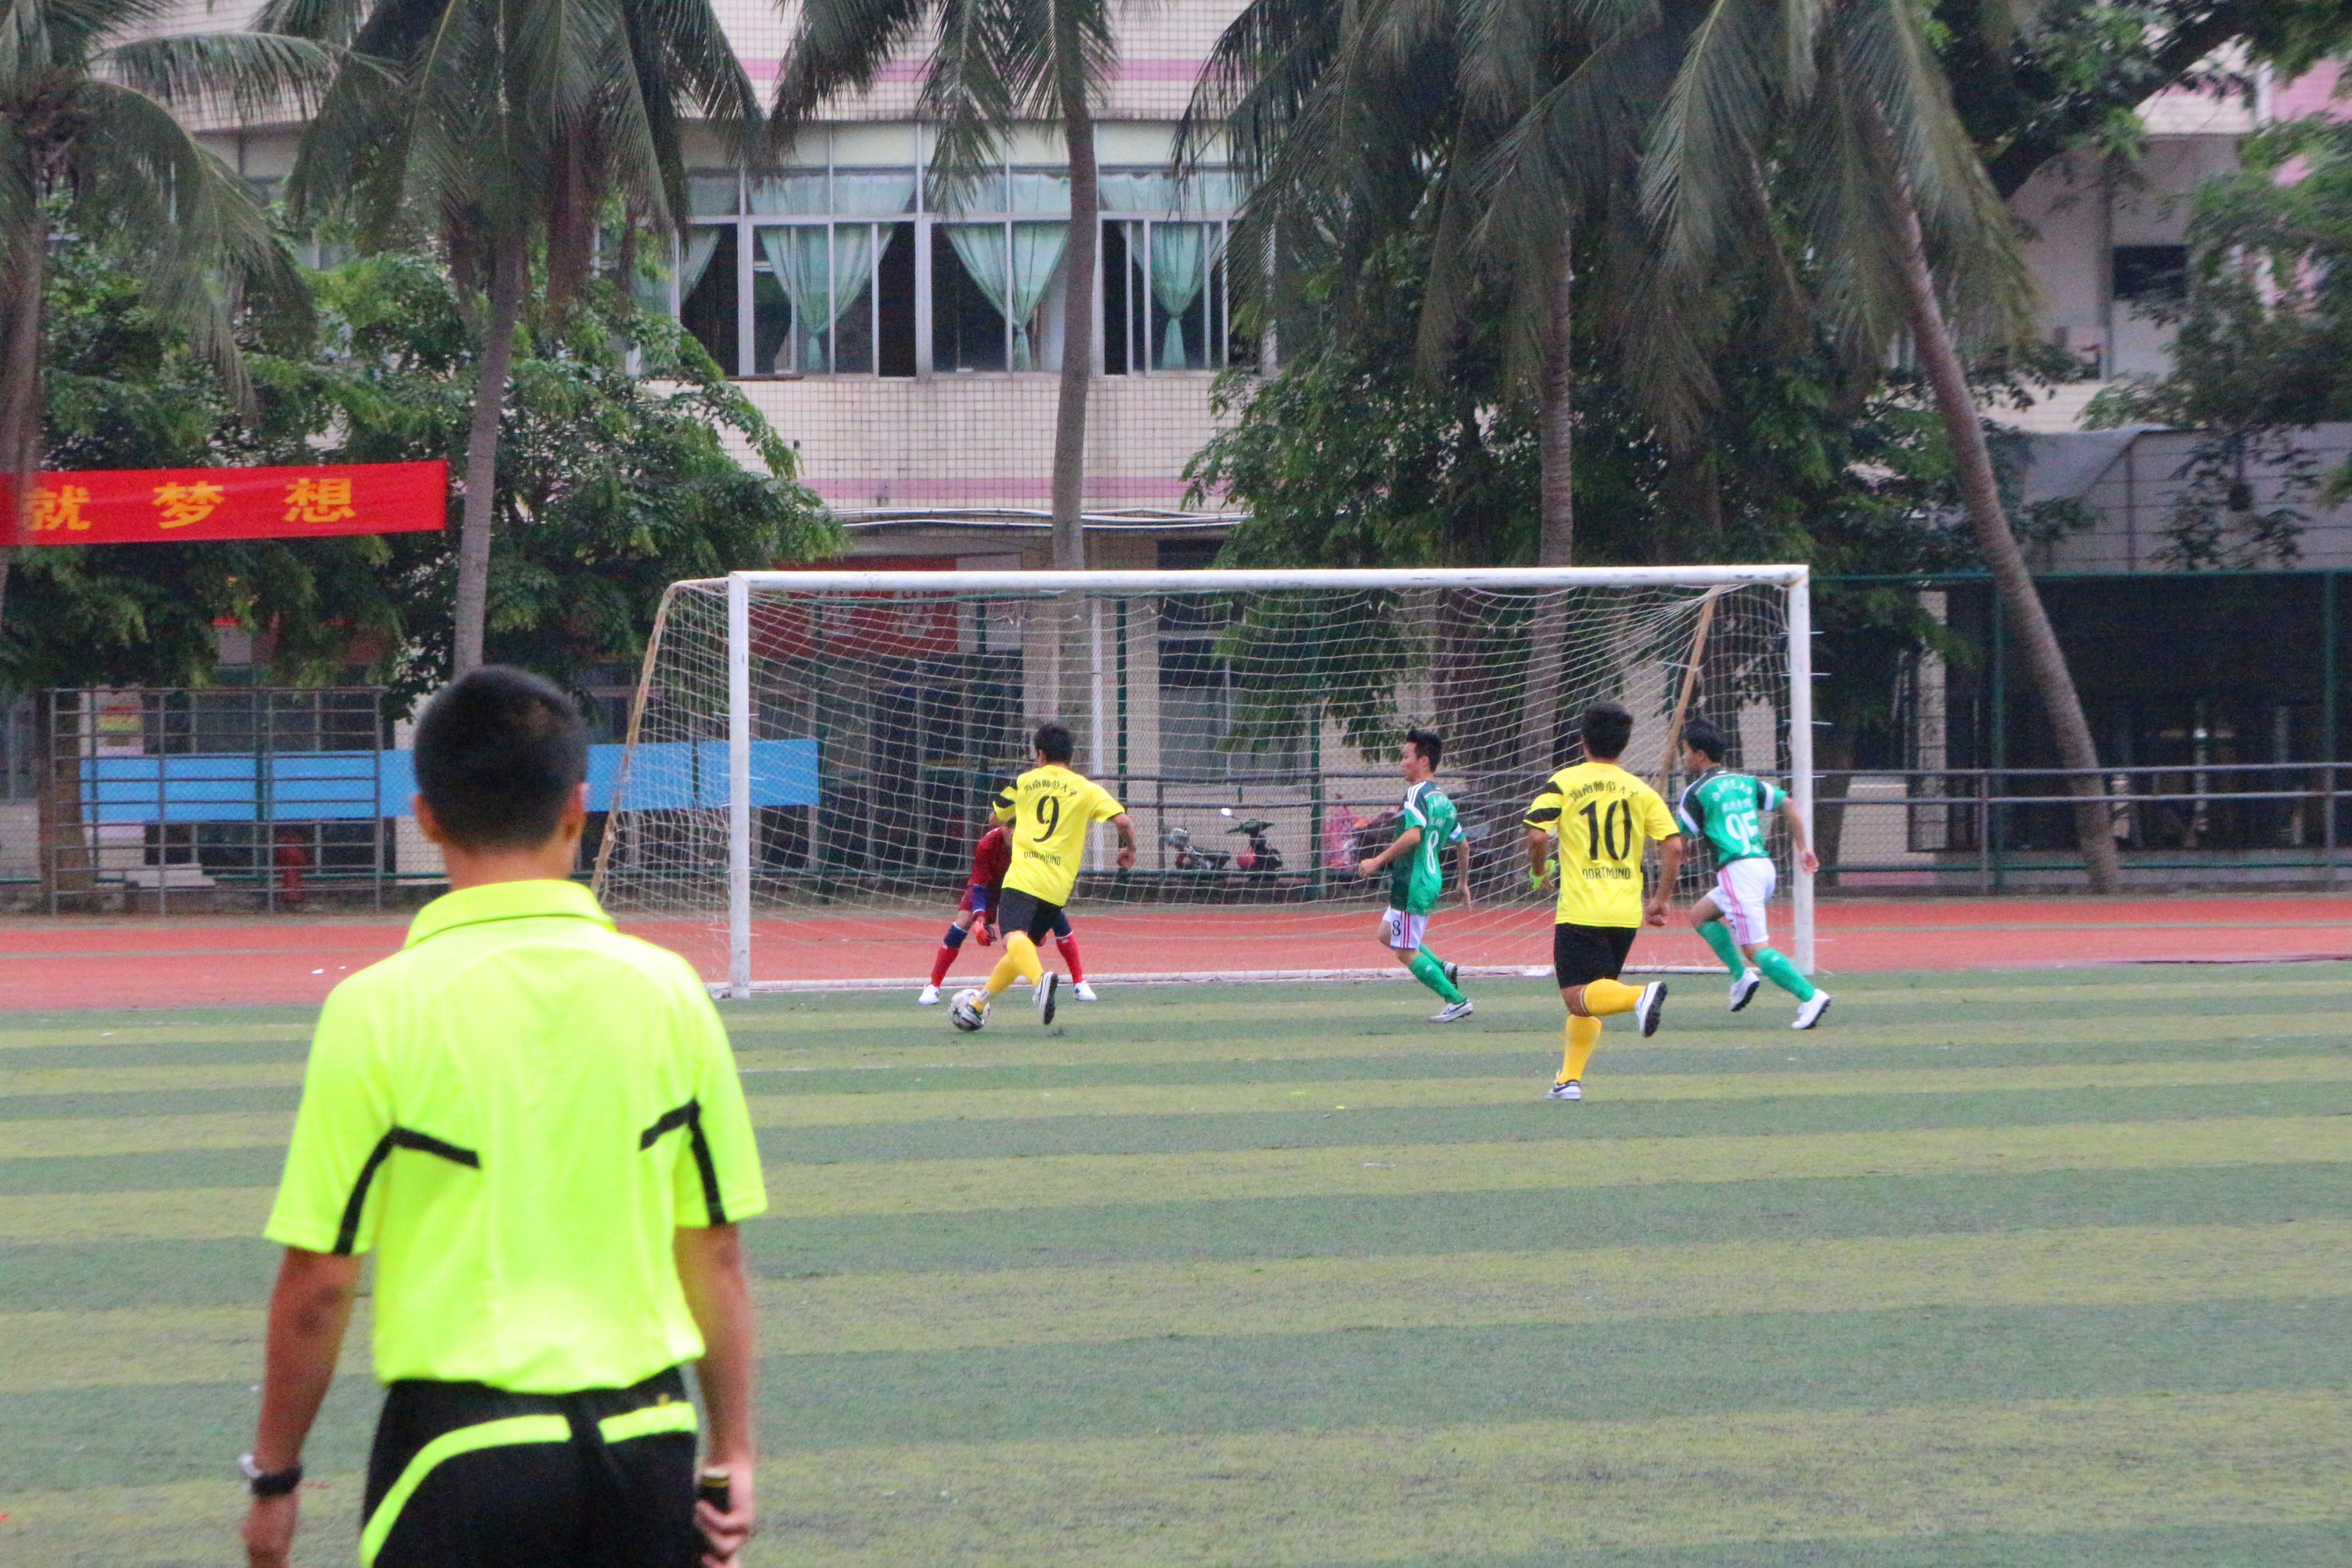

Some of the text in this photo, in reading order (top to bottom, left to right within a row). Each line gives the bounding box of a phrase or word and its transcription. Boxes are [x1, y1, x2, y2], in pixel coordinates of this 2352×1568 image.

[22, 478, 356, 530] 就梦想
[1033, 795, 1059, 843] 9
[1579, 799, 1632, 861] 10
[1426, 830, 1440, 874] 8
[1582, 867, 1631, 880] DORTMUND
[1392, 920, 1401, 936] 8
